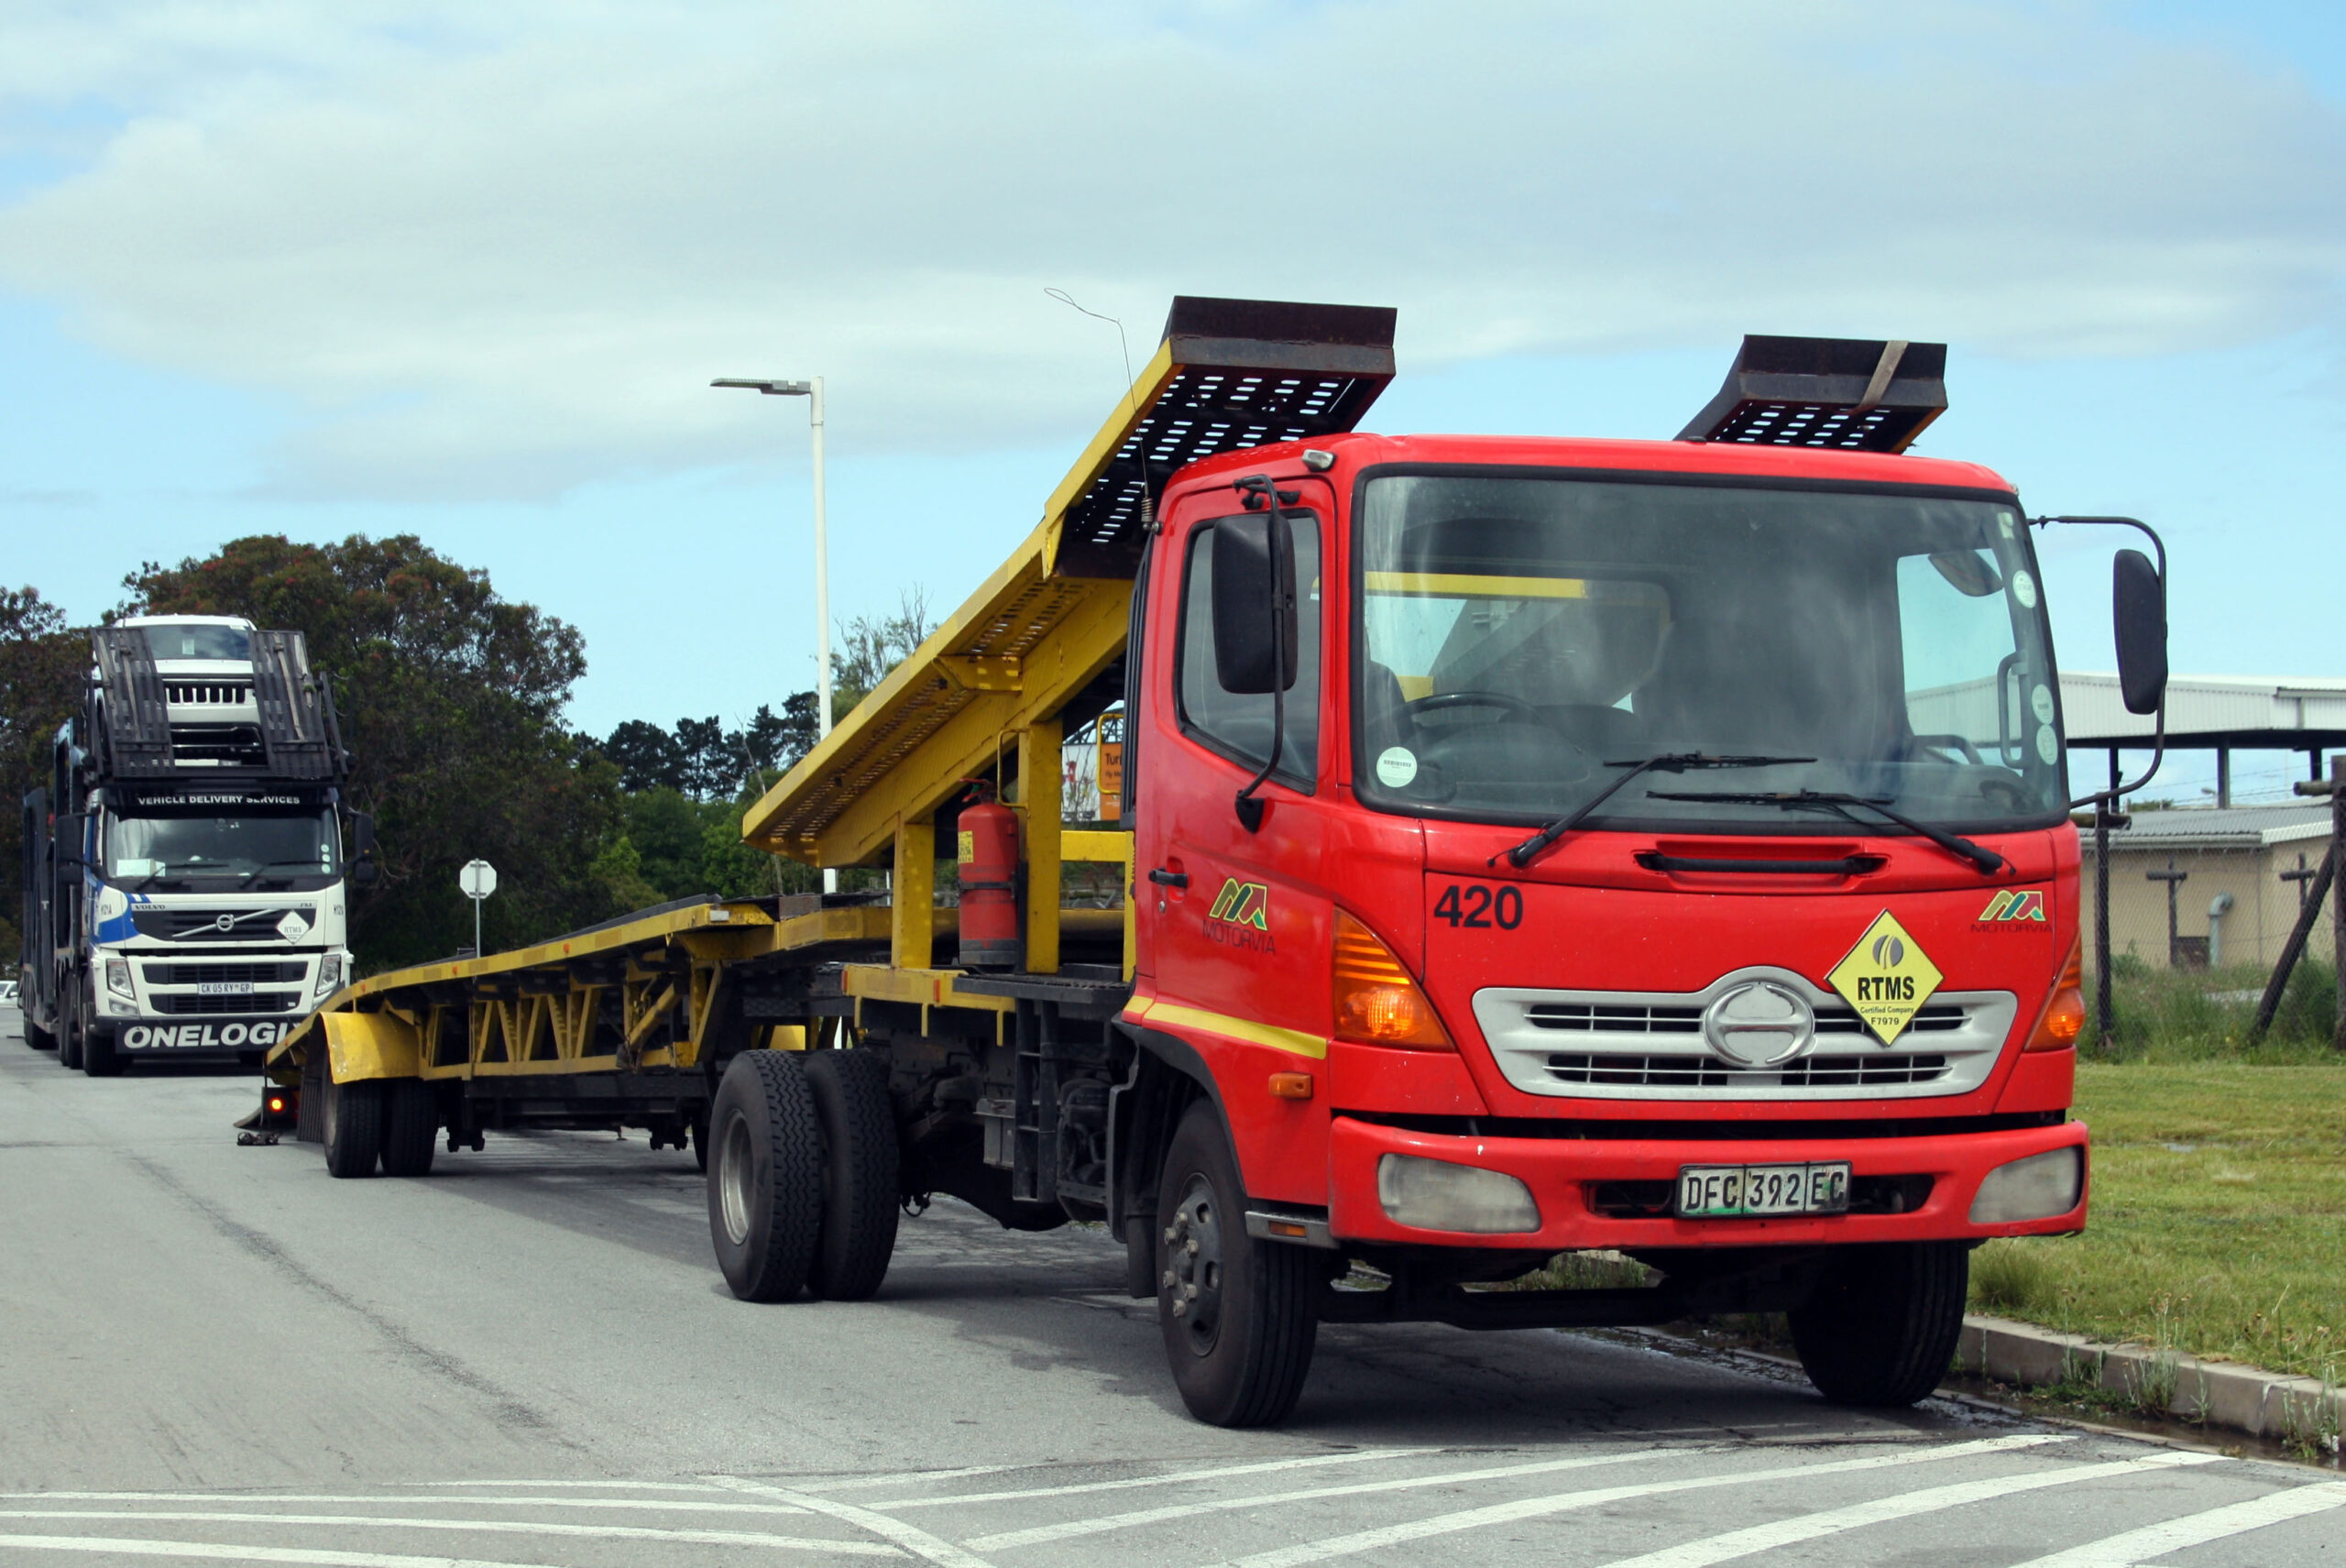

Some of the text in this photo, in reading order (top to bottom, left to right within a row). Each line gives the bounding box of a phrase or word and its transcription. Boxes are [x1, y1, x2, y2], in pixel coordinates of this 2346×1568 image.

[138, 795, 301, 806] VEHICLE DELIVERY SERVICES
[1433, 885, 1523, 930] 420
[1202, 919, 1277, 956] MOTORVIA
[1970, 923, 2053, 933] MOTORVIA
[1858, 976, 1915, 1001] RTMS
[1859, 1005, 1914, 1014] Certified Company
[1870, 1016, 1900, 1025] F7979
[124, 1022, 301, 1049] ONELOGI
[1685, 1171, 1845, 1210] DFC 392 EC
